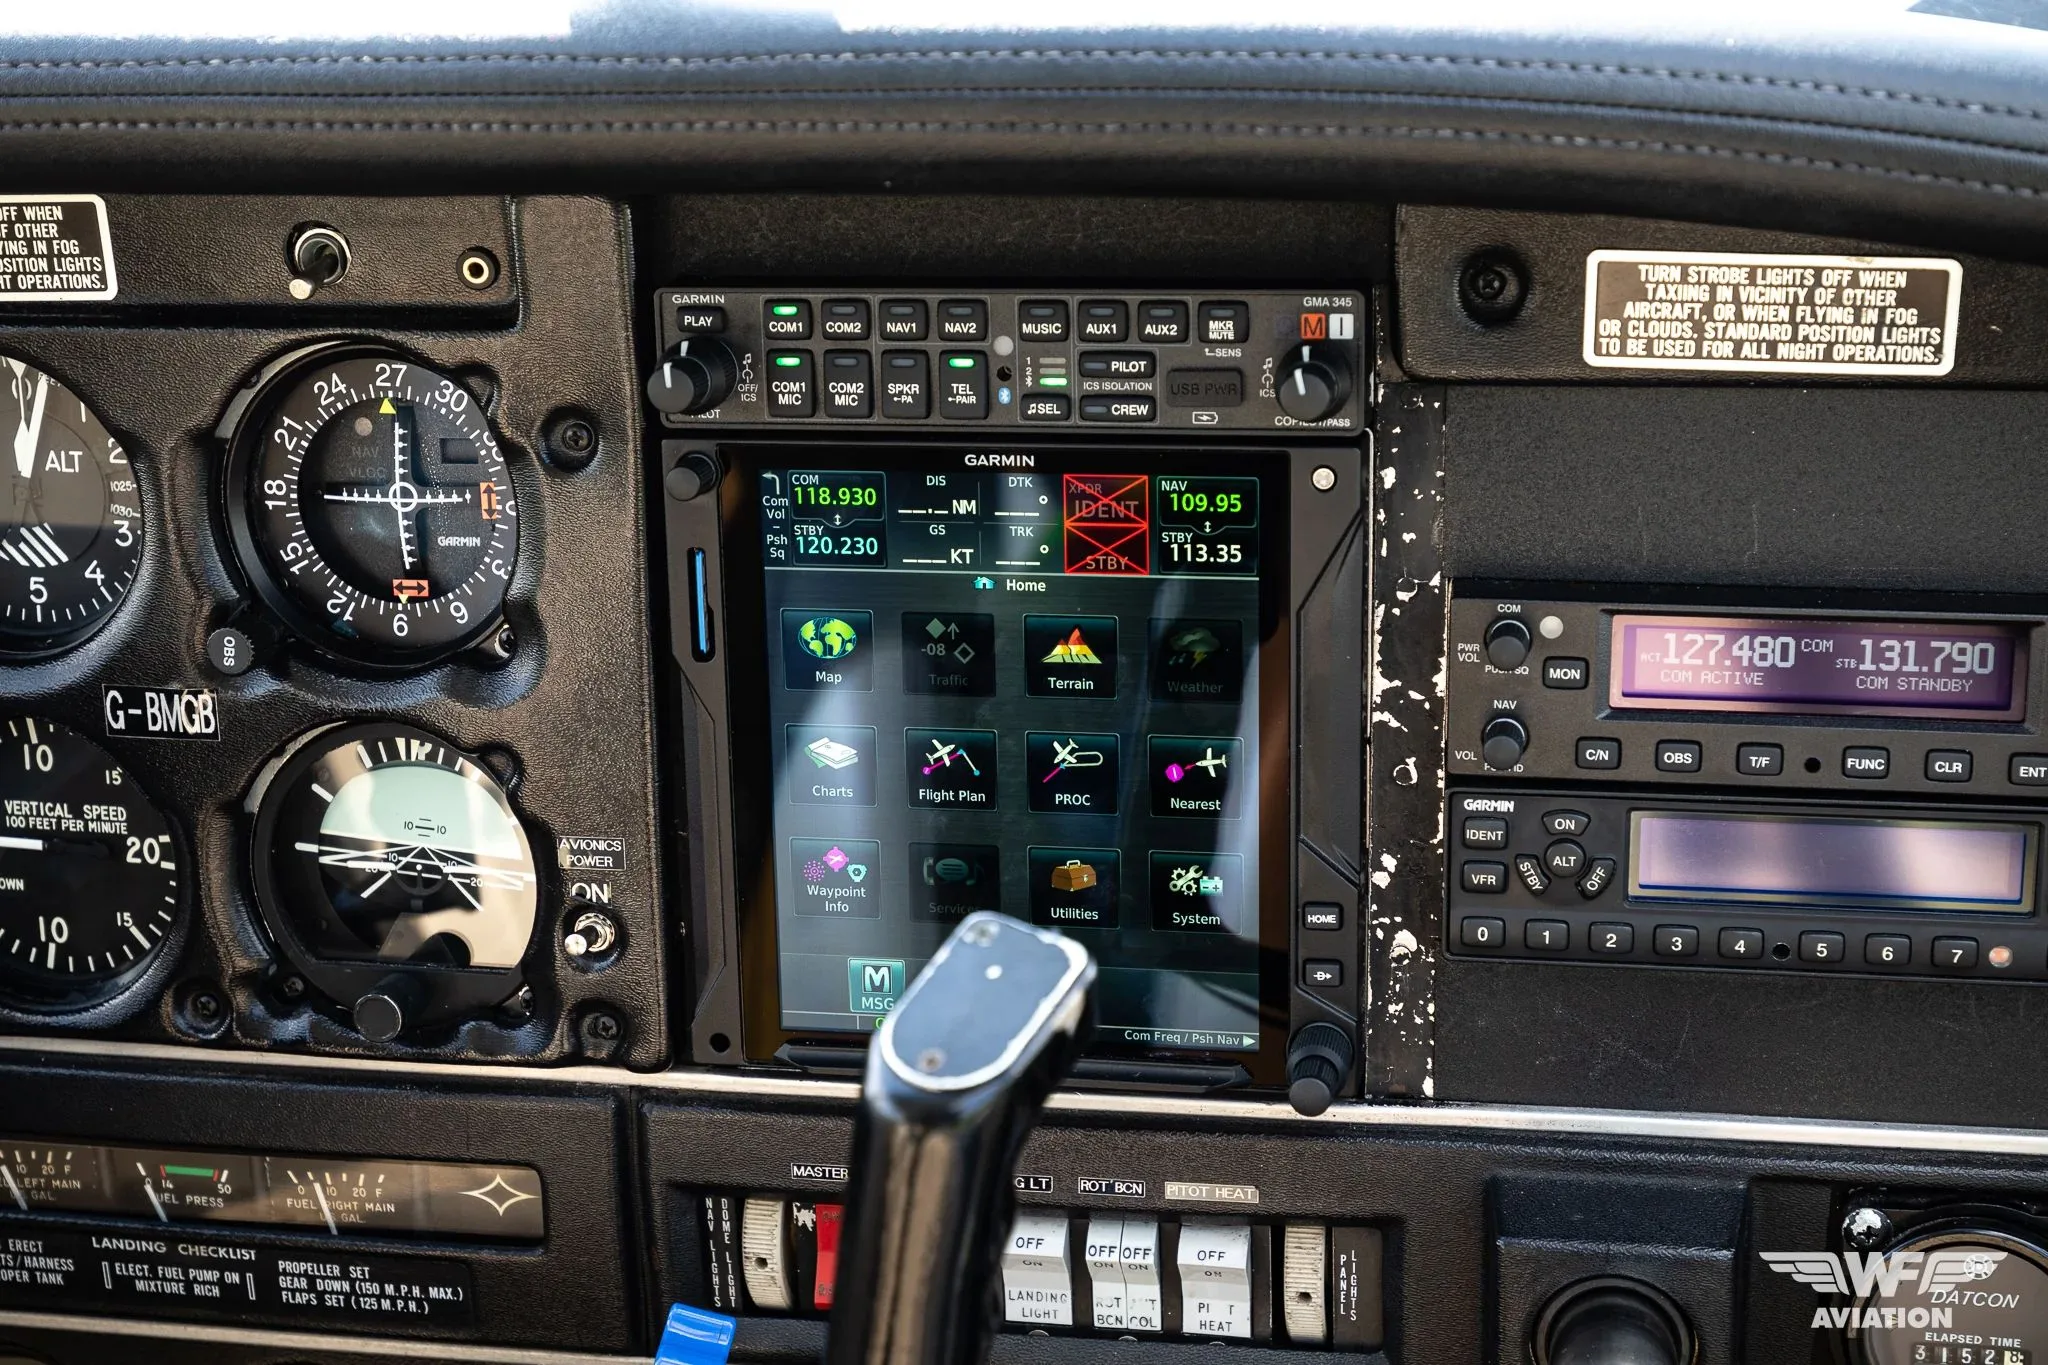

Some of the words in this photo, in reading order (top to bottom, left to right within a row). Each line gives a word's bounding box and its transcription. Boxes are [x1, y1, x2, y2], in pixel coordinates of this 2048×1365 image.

[23, 206, 63, 220] WHEN
[14, 223, 59, 238] OTHER
[53, 240, 79, 254] FOG
[53, 257, 102, 272] LIGHTS
[18, 274, 105, 289] OPERATIONS.
[1639, 265, 1681, 282] TURN
[1687, 266, 1749, 285] STROBE
[1756, 267, 1815, 286] LIGHTS
[1821, 269, 1852, 286] OFF
[1858, 270, 1908, 289] WHEN
[672, 294, 725, 304] GARMIN
[1645, 283, 1710, 302] TAXIING
[1716, 285, 1733, 302] IN
[1739, 286, 1807, 304] VICINITY
[1815, 288, 1836, 305] OF
[1842, 289, 1897, 306] OTHER
[1303, 297, 1330, 307] GMA
[1332, 297, 1353, 308] 345
[1623, 301, 1707, 322] AIRCRAFT,
[1713, 304, 1736, 321] OR
[1742, 304, 1789, 323] WHEN
[1796, 306, 1854, 324] FLYING
[1861, 307, 1878, 325] IN
[1885, 308, 1917, 325] FOG
[684, 316, 713, 328] PLAY
[769, 321, 803, 333] COM1
[826, 321, 862, 334] COM2
[886, 322, 917, 334] NAV1
[945, 322, 977, 334] NAV2
[1209, 320, 1234, 331] MKR
[1022, 323, 1062, 335] MUSIC
[1086, 323, 1117, 335] AUX1
[1144, 323, 1178, 336] AUX2
[1209, 331, 1235, 340] MUTE
[1599, 319, 1622, 337] OR
[1627, 320, 1698, 339] CLOUDS.
[1704, 322, 1793, 341] STANDARD
[1797, 324, 1874, 343] POSITION
[1881, 326, 1941, 345] LIGHTS
[1215, 348, 1242, 357] SENS
[1599, 338, 1621, 355] TO
[1627, 339, 1647, 356] BE
[1653, 339, 1696, 358] USED
[1702, 341, 1734, 359] FOR
[1740, 342, 1771, 359] ALL
[1777, 343, 1826, 361] NIGHT
[1832, 344, 1940, 364] OPERATIONS.
[1111, 361, 1147, 373] PILOT
[772, 381, 806, 393] COM1
[829, 382, 864, 394] COM2
[888, 383, 920, 395] SPKR
[951, 384, 973, 395] TEL
[1083, 382, 1099, 391] ICS
[1101, 382, 1153, 392] ISOLATION
[778, 394, 802, 405] MIC
[835, 394, 859, 406] MIC
[901, 395, 913, 404] PA
[955, 395, 977, 404] PAIR
[1037, 404, 1060, 415] SEL
[1111, 404, 1149, 416] CREW
[45, 450, 83, 473] ALT
[964, 454, 1035, 467] GARMIN
[791, 474, 819, 486] COM
[926, 475, 947, 486] DIS
[1008, 477, 1033, 488] DTK
[1161, 481, 1188, 491] NAV
[762, 496, 789, 506] Com
[794, 487, 877, 506] 118.930
[1170, 493, 1242, 512] 109.95
[952, 499, 976, 515] NM
[766, 508, 785, 520] Vol
[793, 525, 824, 536] STBY
[929, 525, 946, 535] GS
[1009, 526, 1034, 537] TRK
[437, 536, 481, 547] GARMIN
[766, 534, 788, 545] Psh
[1161, 532, 1193, 543] STBY
[796, 536, 878, 555] 120.230
[769, 548, 785, 560] Sq
[950, 548, 974, 564] KT
[1170, 544, 1242, 563] 113.35
[1006, 579, 1046, 591] Home
[1497, 604, 1521, 613] COM
[222, 636, 236, 667] OBS
[1663, 632, 1796, 668] 127.480
[1801, 639, 1833, 653] COM
[1859, 639, 1995, 674] 131.790
[815, 671, 842, 684] Map
[1549, 669, 1580, 680] MON
[1661, 670, 1692, 682] COM
[1701, 671, 1764, 686] ACTIVE
[1048, 677, 1094, 690] Terrain
[1856, 676, 1888, 689] COM
[1897, 677, 1972, 692] STANDBY
[1493, 700, 1517, 709] NAV
[106, 690, 215, 734] G-BMGB
[1586, 750, 1609, 761] C/N
[1663, 752, 1692, 764] OBS
[1750, 757, 1770, 768] T/F
[1847, 759, 1885, 770] FUNC
[1935, 762, 1962, 773] CLR
[2020, 766, 2047, 777] ENT
[812, 785, 854, 798] Charts
[919, 788, 954, 803] Flight
[958, 790, 986, 802] Plan
[1055, 793, 1091, 806] PROC
[1170, 797, 1221, 811] Nearest
[1464, 799, 1514, 812] GARMIN
[5, 800, 73, 818] VERTICAL
[83, 805, 126, 821] SPEED
[6, 816, 25, 828] 100
[29, 818, 57, 831] FEET
[61, 819, 84, 832] PER
[88, 820, 128, 835] MINUTE
[1555, 819, 1575, 830] ON
[1466, 830, 1503, 841] IDENT
[559, 838, 622, 851] AVIONICS
[566, 854, 613, 867] POWER
[1553, 856, 1576, 867] ALT
[1472, 875, 1496, 885] VFR
[1519, 861, 1544, 892] STBY
[1586, 866, 1606, 891] OFF
[571, 883, 608, 903] ON
[807, 885, 866, 898] Waypoint
[825, 901, 849, 913] Info
[1050, 906, 1099, 920] Utilities
[1172, 912, 1220, 926] System
[1308, 914, 1336, 923] HOME
[861, 997, 894, 1010] MSG
[1124, 1030, 1150, 1041] Com
[1154, 1032, 1181, 1045] Freq
[1192, 1033, 1213, 1045] Psh
[1217, 1035, 1240, 1045] Nav
[793, 1165, 849, 1179] MASTER
[1080, 1180, 1108, 1192] ROT
[1115, 1181, 1143, 1195] BCN
[1167, 1184, 1209, 1198] PITOT
[1215, 1187, 1257, 1200] HEAT
[186, 1195, 224, 1208] PRESS
[286, 1198, 317, 1210] FUEL
[365, 1202, 395, 1213] MAIN
[92, 1236, 167, 1253] LANDING
[178, 1243, 256, 1261] CHECKLIST
[1015, 1237, 1045, 1250] OFF
[1197, 1249, 1226, 1262] OFF
[115, 1263, 153, 1277] ELECT.
[158, 1266, 185, 1281] FUEL
[189, 1269, 220, 1283] PUMP
[224, 1271, 240, 1284] ON
[278, 1260, 340, 1277] PROPELLER
[349, 1266, 370, 1279] SET
[135, 1279, 185, 1295] MIXTURE
[194, 1283, 220, 1297] RICH
[279, 1276, 307, 1290] GEAR
[316, 1278, 350, 1293] DOWN
[385, 1283, 425, 1299] M.P.H.
[429, 1287, 463, 1301] MAX.)
[282, 1291, 317, 1305] FLAPS
[324, 1294, 345, 1307] SET
[1930, 1290, 2019, 1308] DATCON
[1021, 1306, 1060, 1321] LIGHT
[1925, 1332, 1983, 1345] ELAPSED
[1989, 1336, 2021, 1348] TIME
